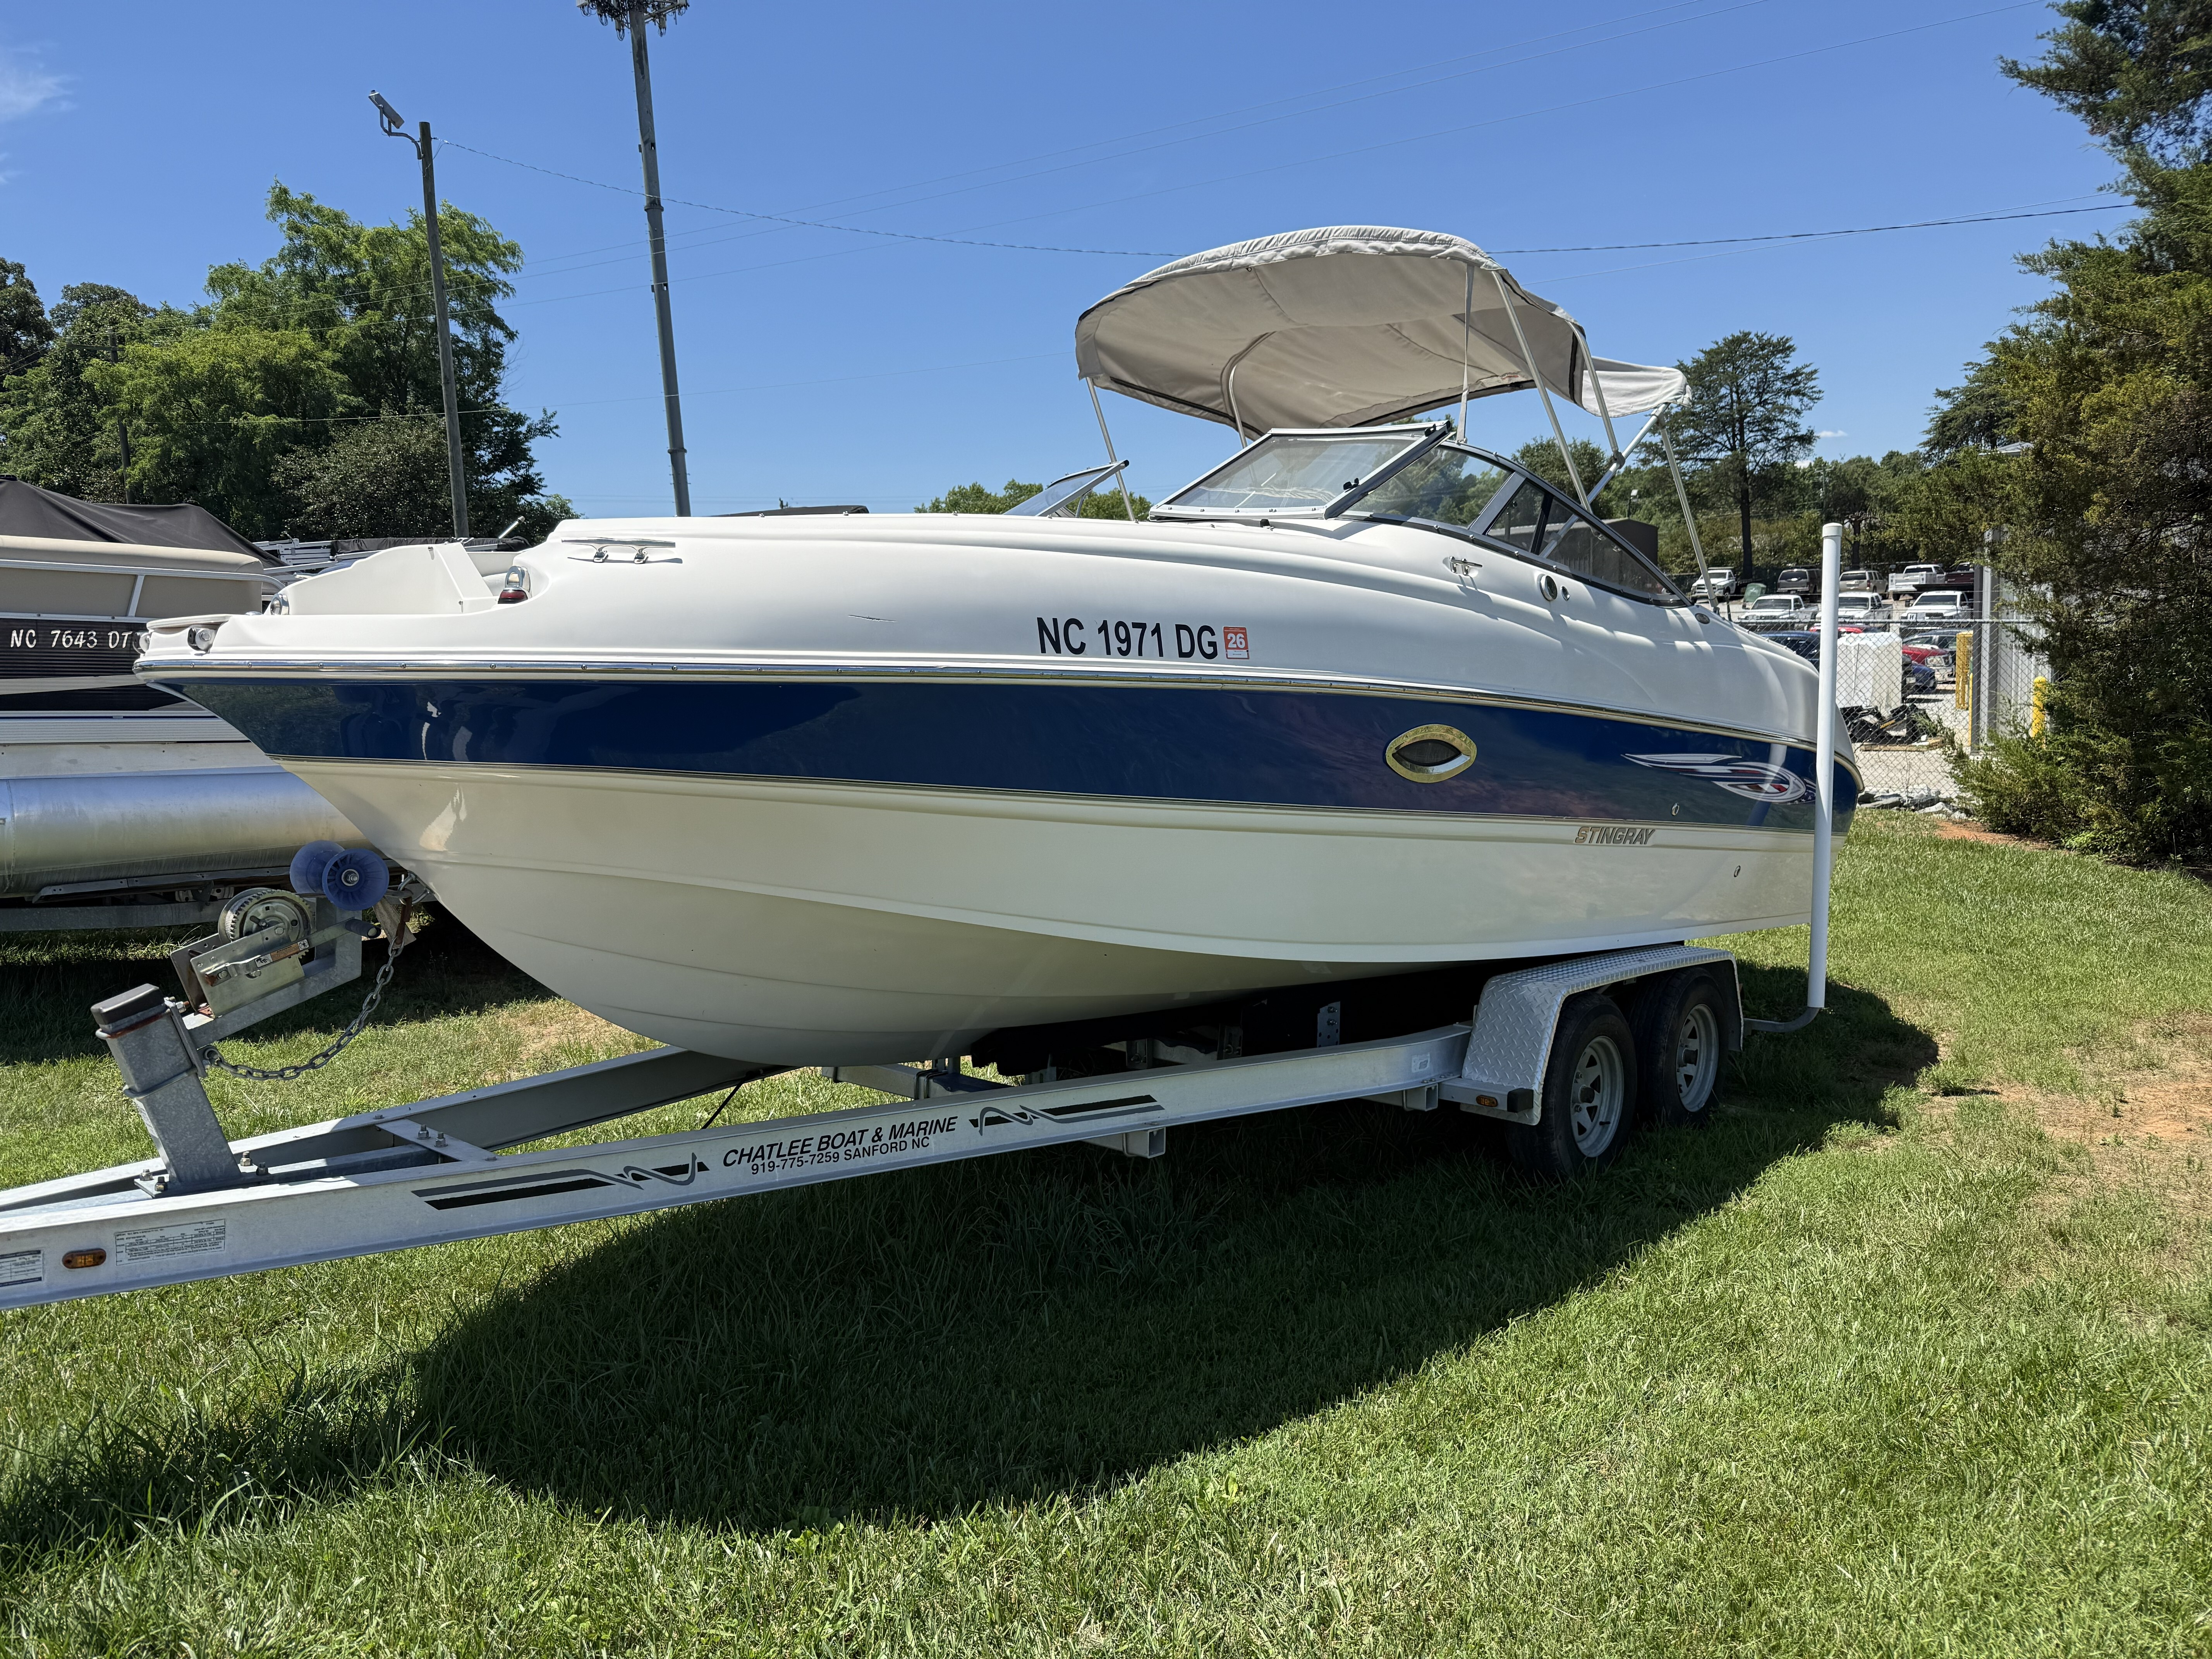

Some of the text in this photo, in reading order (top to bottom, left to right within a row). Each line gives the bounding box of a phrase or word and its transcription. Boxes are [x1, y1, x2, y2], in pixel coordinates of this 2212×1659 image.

[10, 629, 132, 649] NC 7643 DT
[1037, 617, 1218, 659] NC 1971 DG
[1227, 633, 1245, 648] 26
[1575, 826, 1656, 845] STINGRAY
[723, 1116, 958, 1167] CHATLEE BOAT & MARINE
[751, 1137, 930, 1175] 919-775-7259 SANFORD NC
